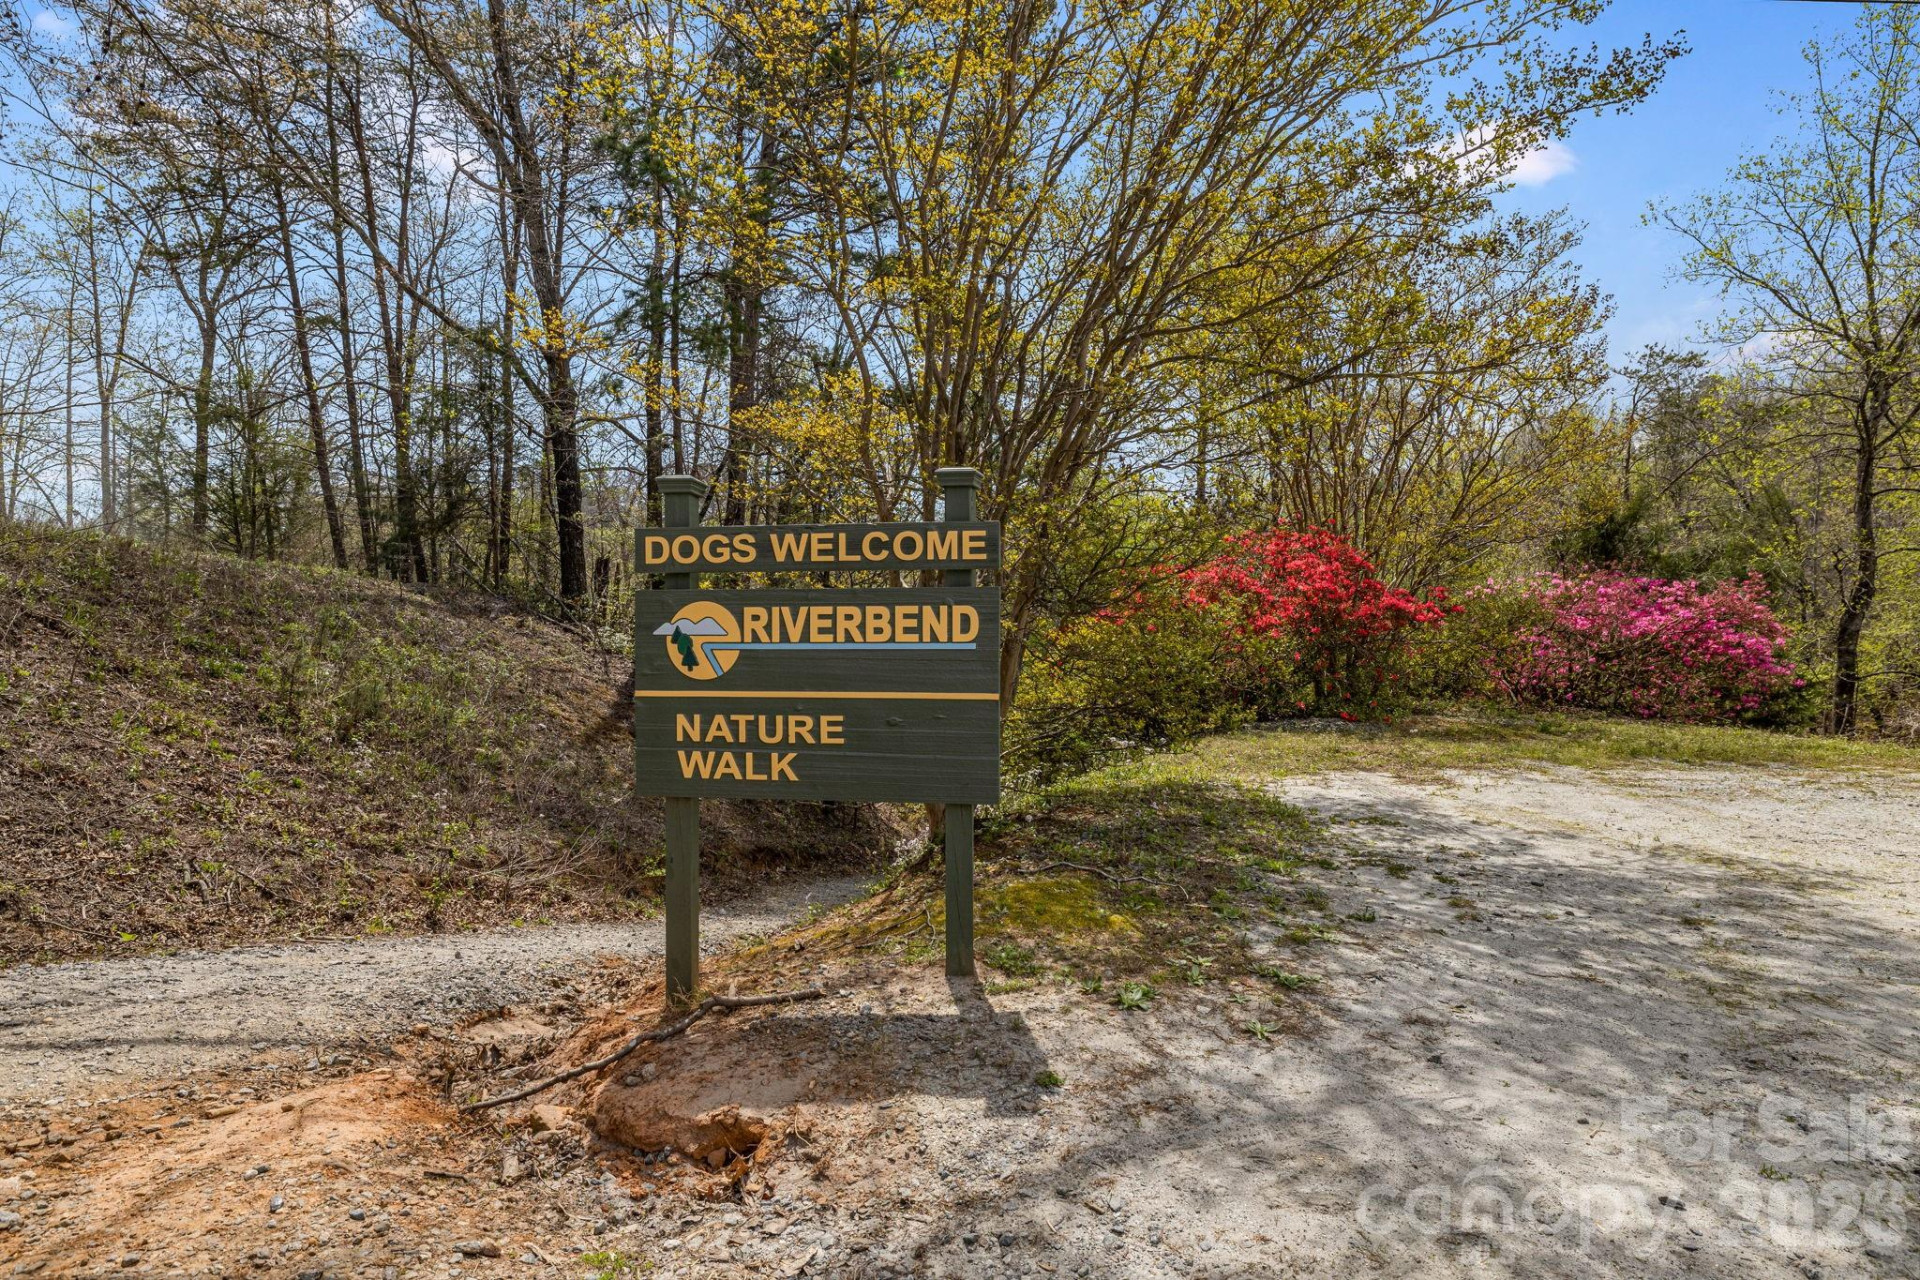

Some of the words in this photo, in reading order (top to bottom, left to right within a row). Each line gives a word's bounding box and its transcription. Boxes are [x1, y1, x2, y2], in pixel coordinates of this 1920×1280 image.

[644, 534, 757, 565] DOGS
[769, 530, 988, 562] WELCOME
[743, 605, 980, 643] RIVERBEND
[675, 713, 846, 745] NATURE
[677, 750, 800, 782] WALK
